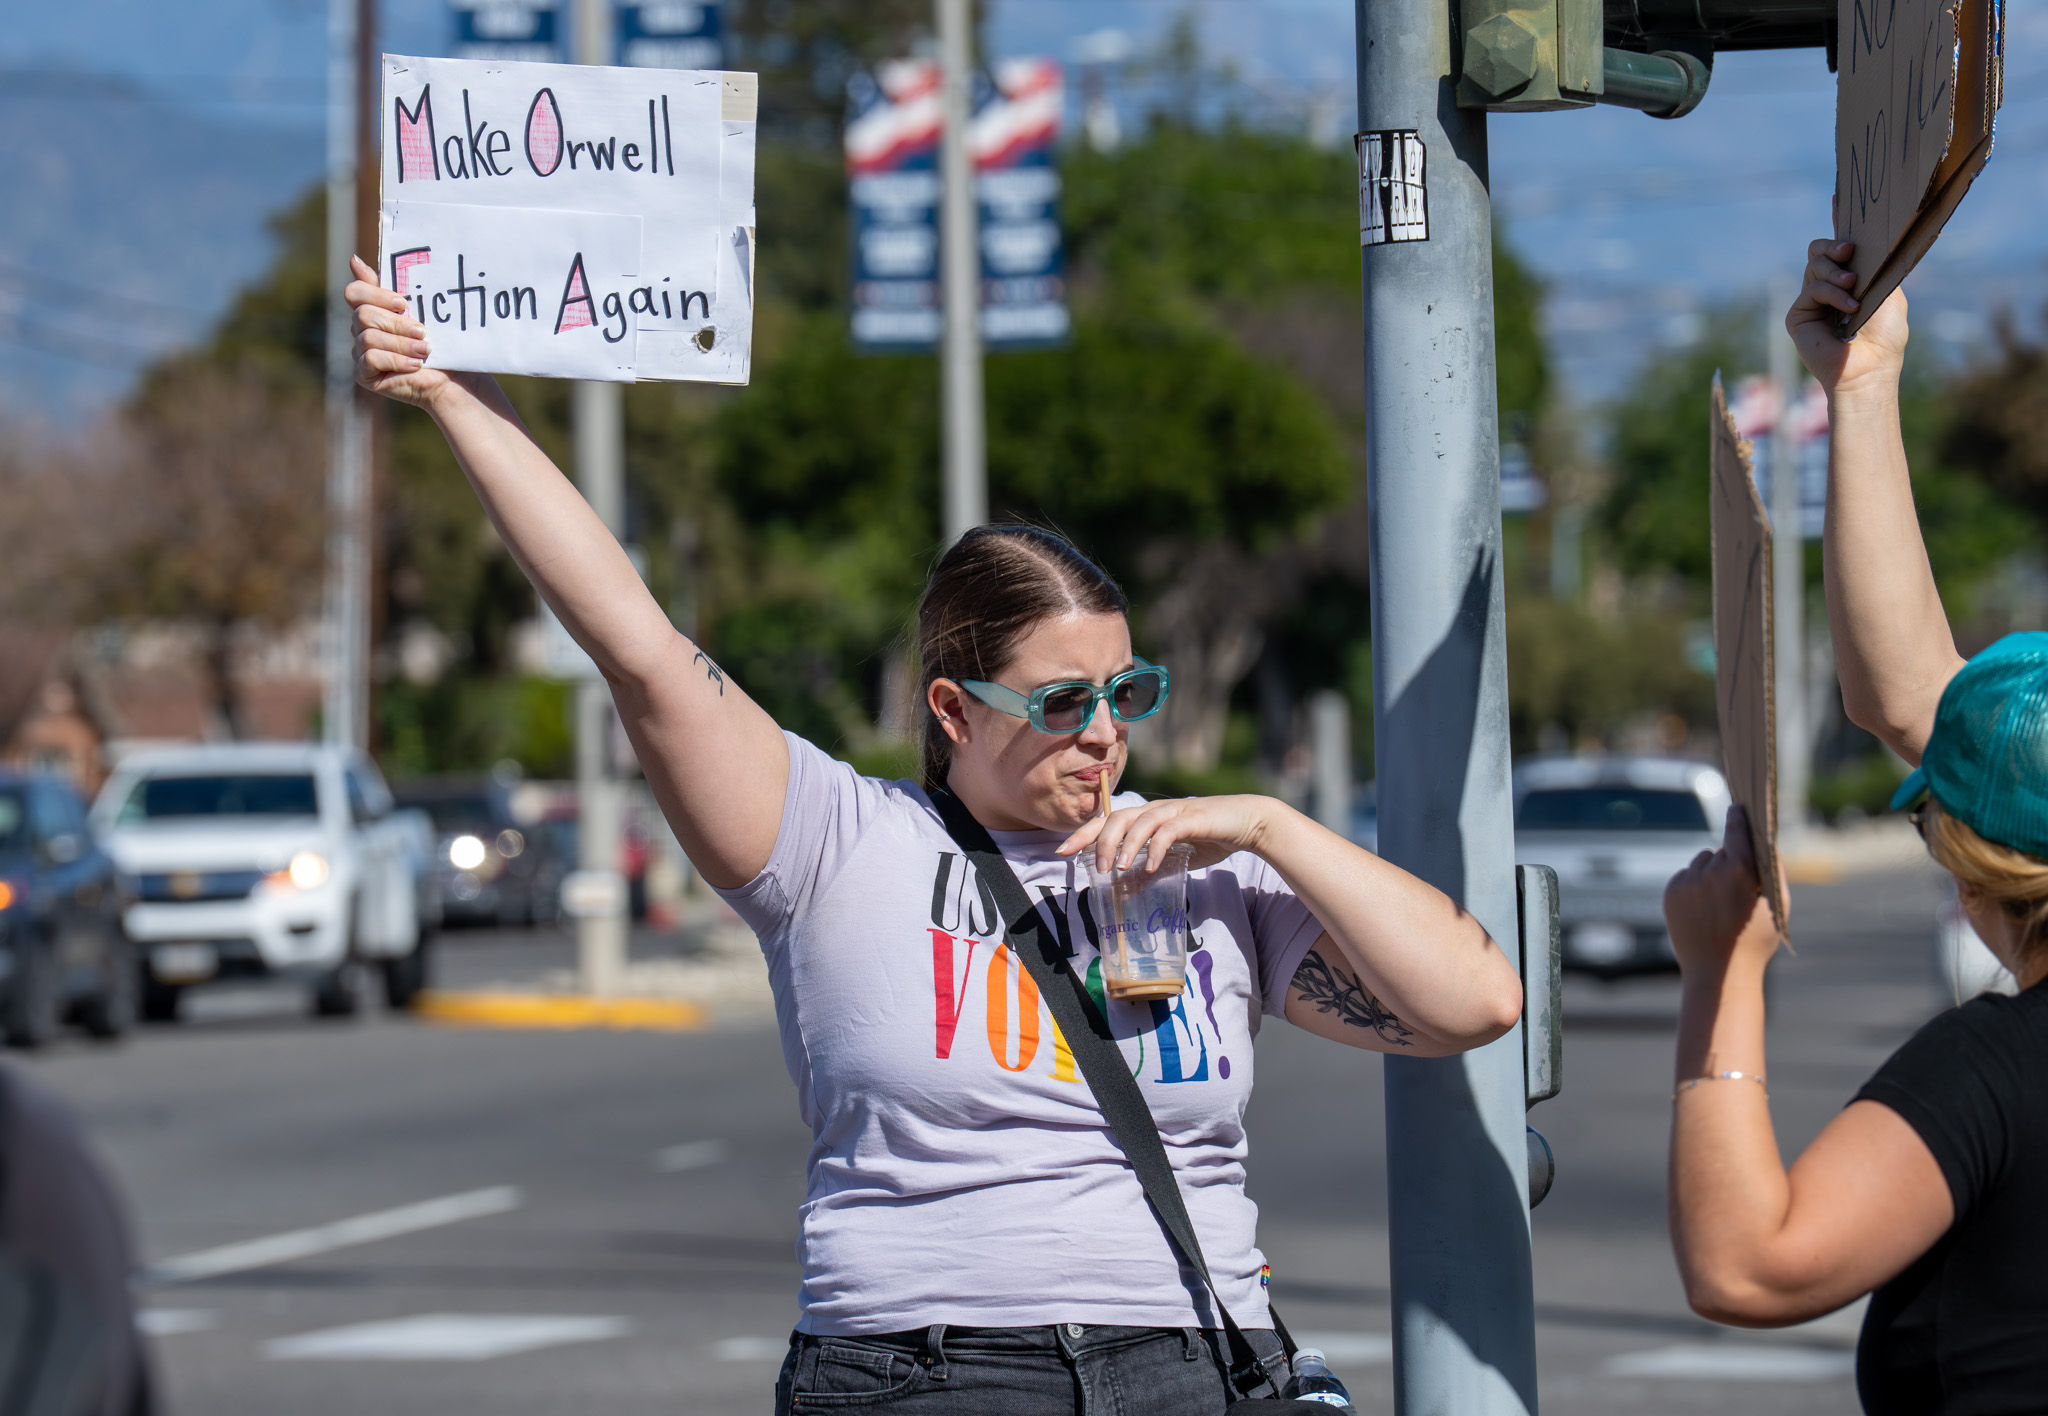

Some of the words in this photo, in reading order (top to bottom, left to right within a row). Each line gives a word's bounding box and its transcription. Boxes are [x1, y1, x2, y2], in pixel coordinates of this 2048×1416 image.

[394, 83, 513, 183] Make
[523, 87, 674, 178] Orwell
[1849, 109, 1887, 238] NO
[390, 245, 538, 332] Fiction
[553, 251, 711, 344] Again
[931, 851, 1017, 952] US
[1098, 918, 1140, 940] rganic
[1146, 907, 1188, 935] Coff
